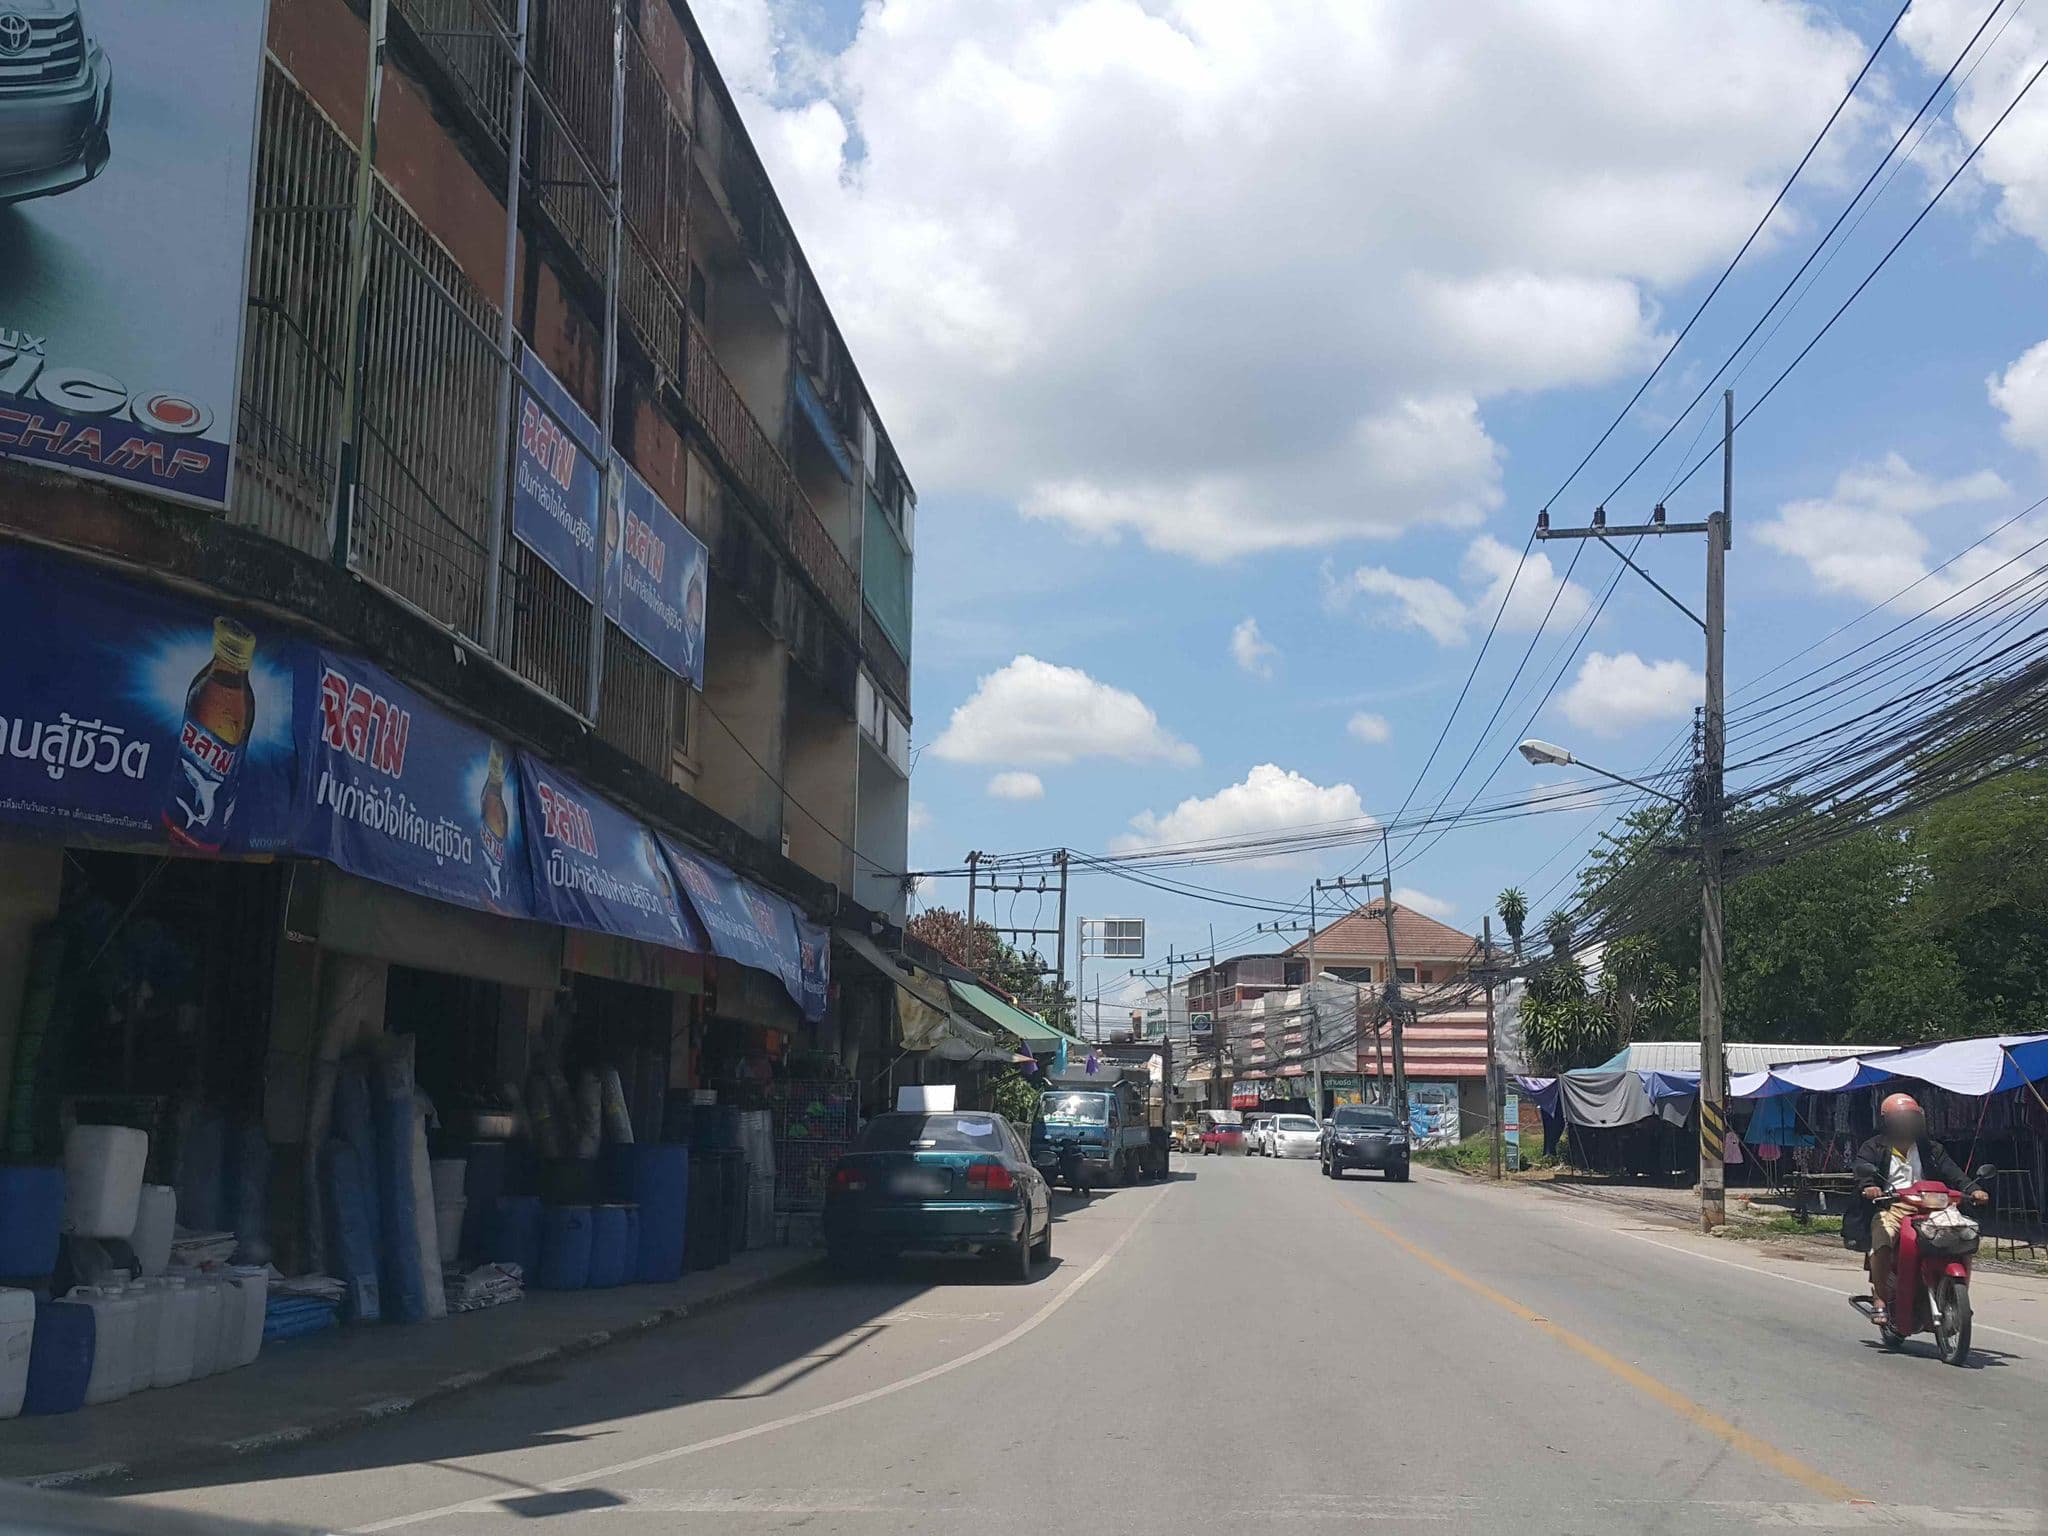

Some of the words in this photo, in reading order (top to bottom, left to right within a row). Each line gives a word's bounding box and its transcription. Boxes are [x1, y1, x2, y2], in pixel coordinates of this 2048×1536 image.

[521, 396, 577, 491] ฉลาม
[625, 509, 666, 585] ฉลาม
[180, 720, 236, 776] ฉลาม
[320, 668, 411, 780] ฉลาม
[316, 770, 473, 868] เนกำลังใจให้คนสู้ชีวิต
